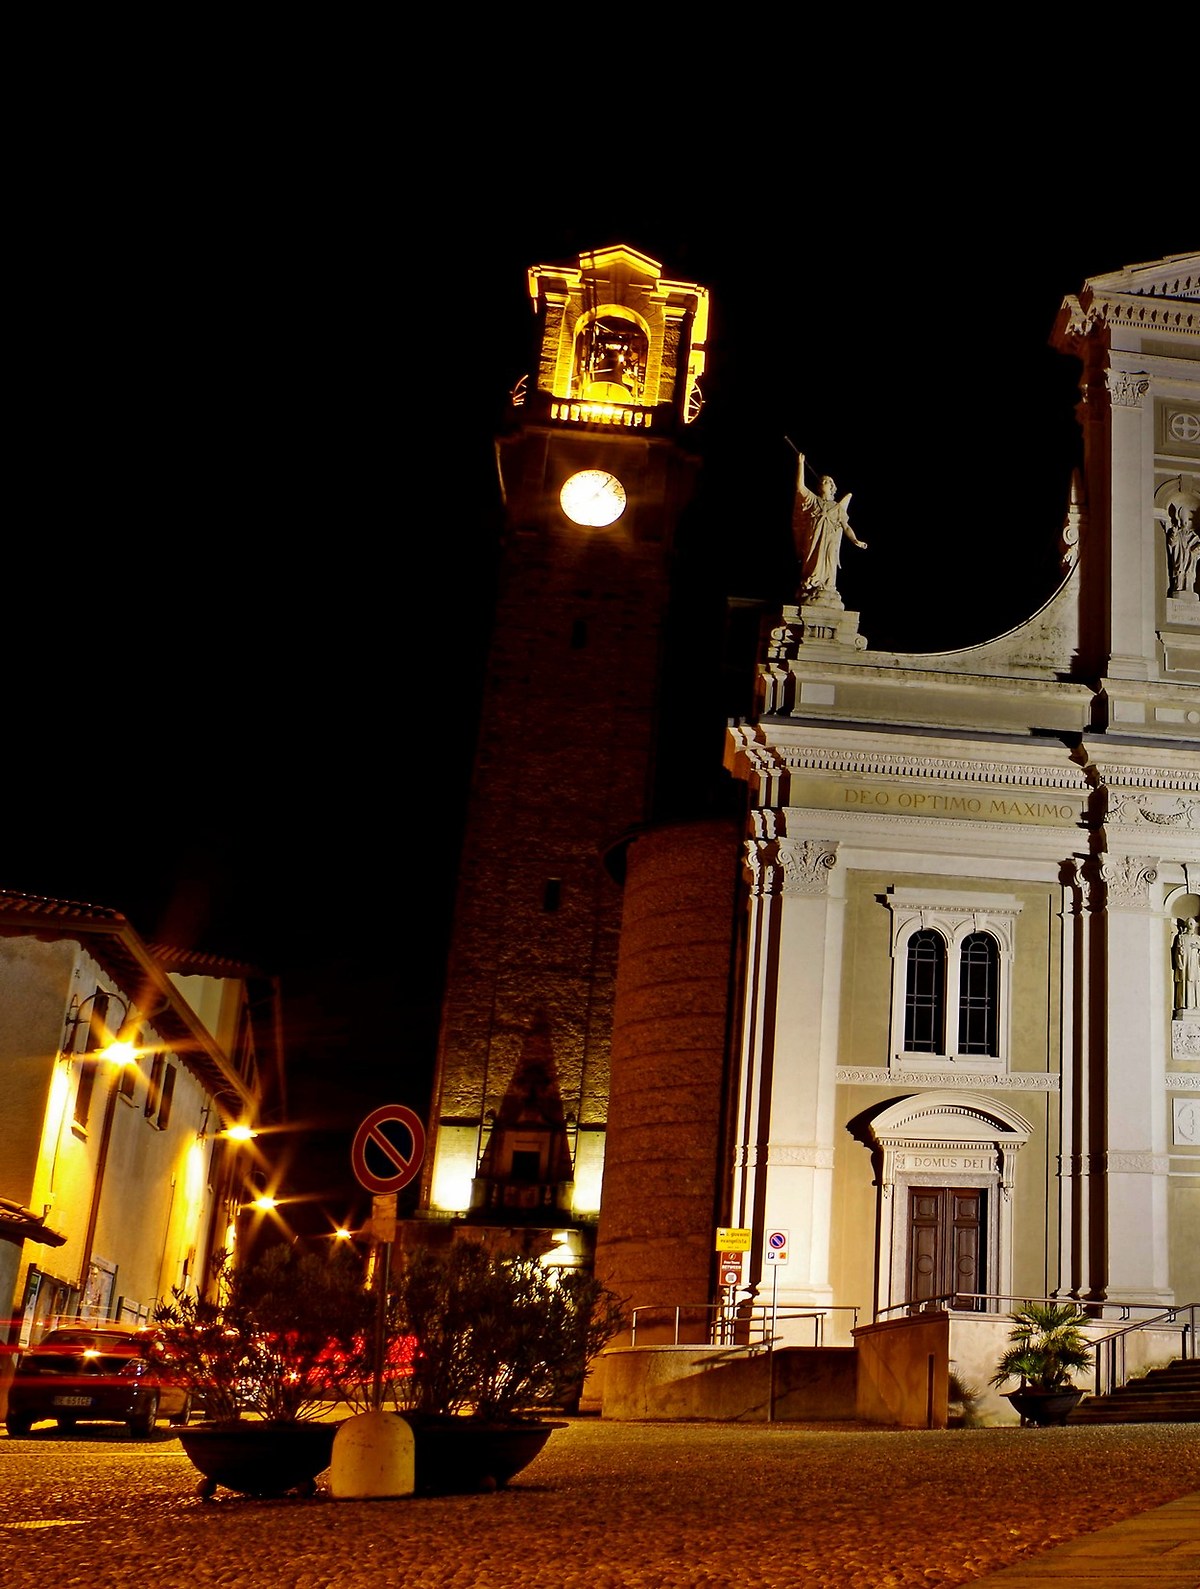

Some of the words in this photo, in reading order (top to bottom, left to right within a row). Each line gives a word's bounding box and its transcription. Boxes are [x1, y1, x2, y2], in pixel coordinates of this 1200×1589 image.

[844, 789, 889, 805] DEO
[897, 792, 982, 813] OPTIMO
[989, 800, 1073, 820] MAXIMO
[914, 1157, 957, 1168] DOMUS
[963, 1159, 983, 1169] DEI
